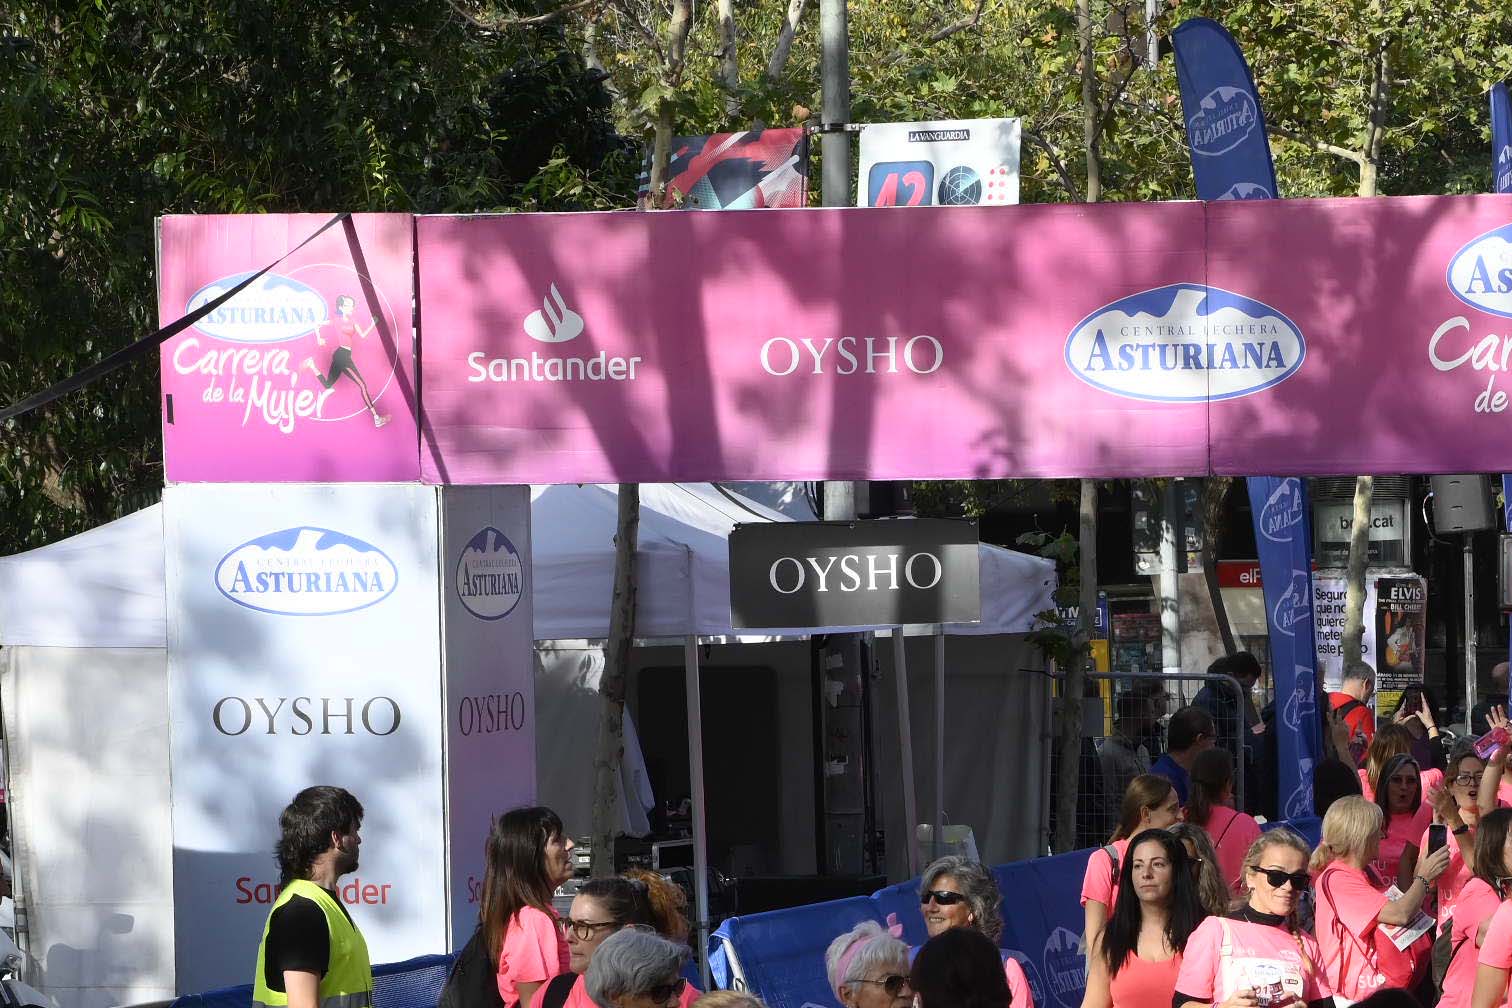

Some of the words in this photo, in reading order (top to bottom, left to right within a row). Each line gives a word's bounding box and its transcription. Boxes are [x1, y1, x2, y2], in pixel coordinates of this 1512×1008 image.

[173, 337, 291, 375] Carrera
[467, 349, 642, 382] Santander
[759, 335, 944, 377] OYSHO
[1084, 328, 1287, 372] ASTURIANA
[202, 378, 223, 403] de
[229, 377, 245, 403] la
[241, 371, 336, 434] Mujer
[1474, 374, 1509, 414] de
[230, 559, 385, 594] ASTURIANA
[461, 561, 520, 597] ASTURIANA
[769, 552, 943, 594] OYSHO
[1391, 587, 1421, 600] ELVIS
[212, 695, 401, 737] OYSHO
[458, 691, 526, 738] OYSHO
